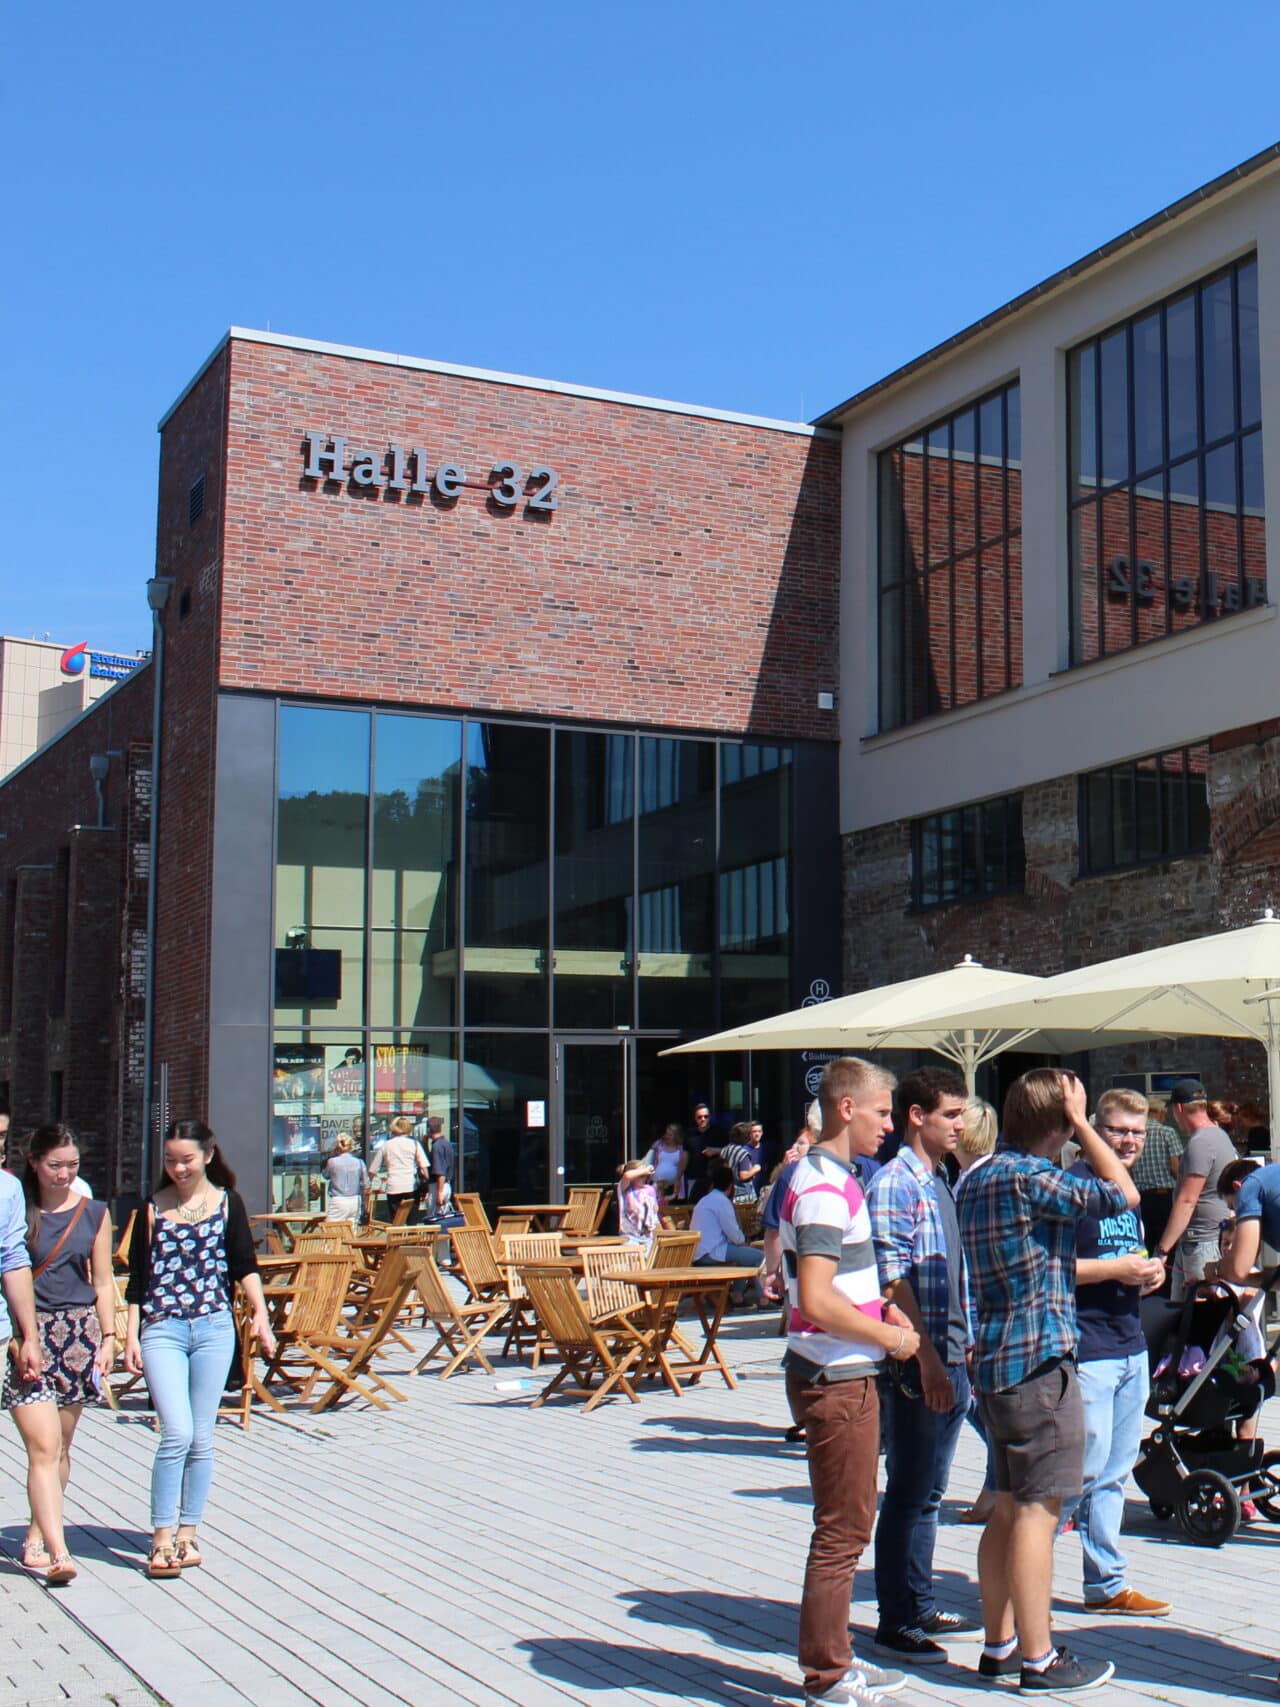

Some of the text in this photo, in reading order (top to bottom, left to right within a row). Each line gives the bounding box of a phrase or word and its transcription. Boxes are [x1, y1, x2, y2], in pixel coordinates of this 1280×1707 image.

[305, 431, 560, 511] Halle 32
[815, 983, 824, 995] H
[321, 1119, 350, 1129] DAVE
